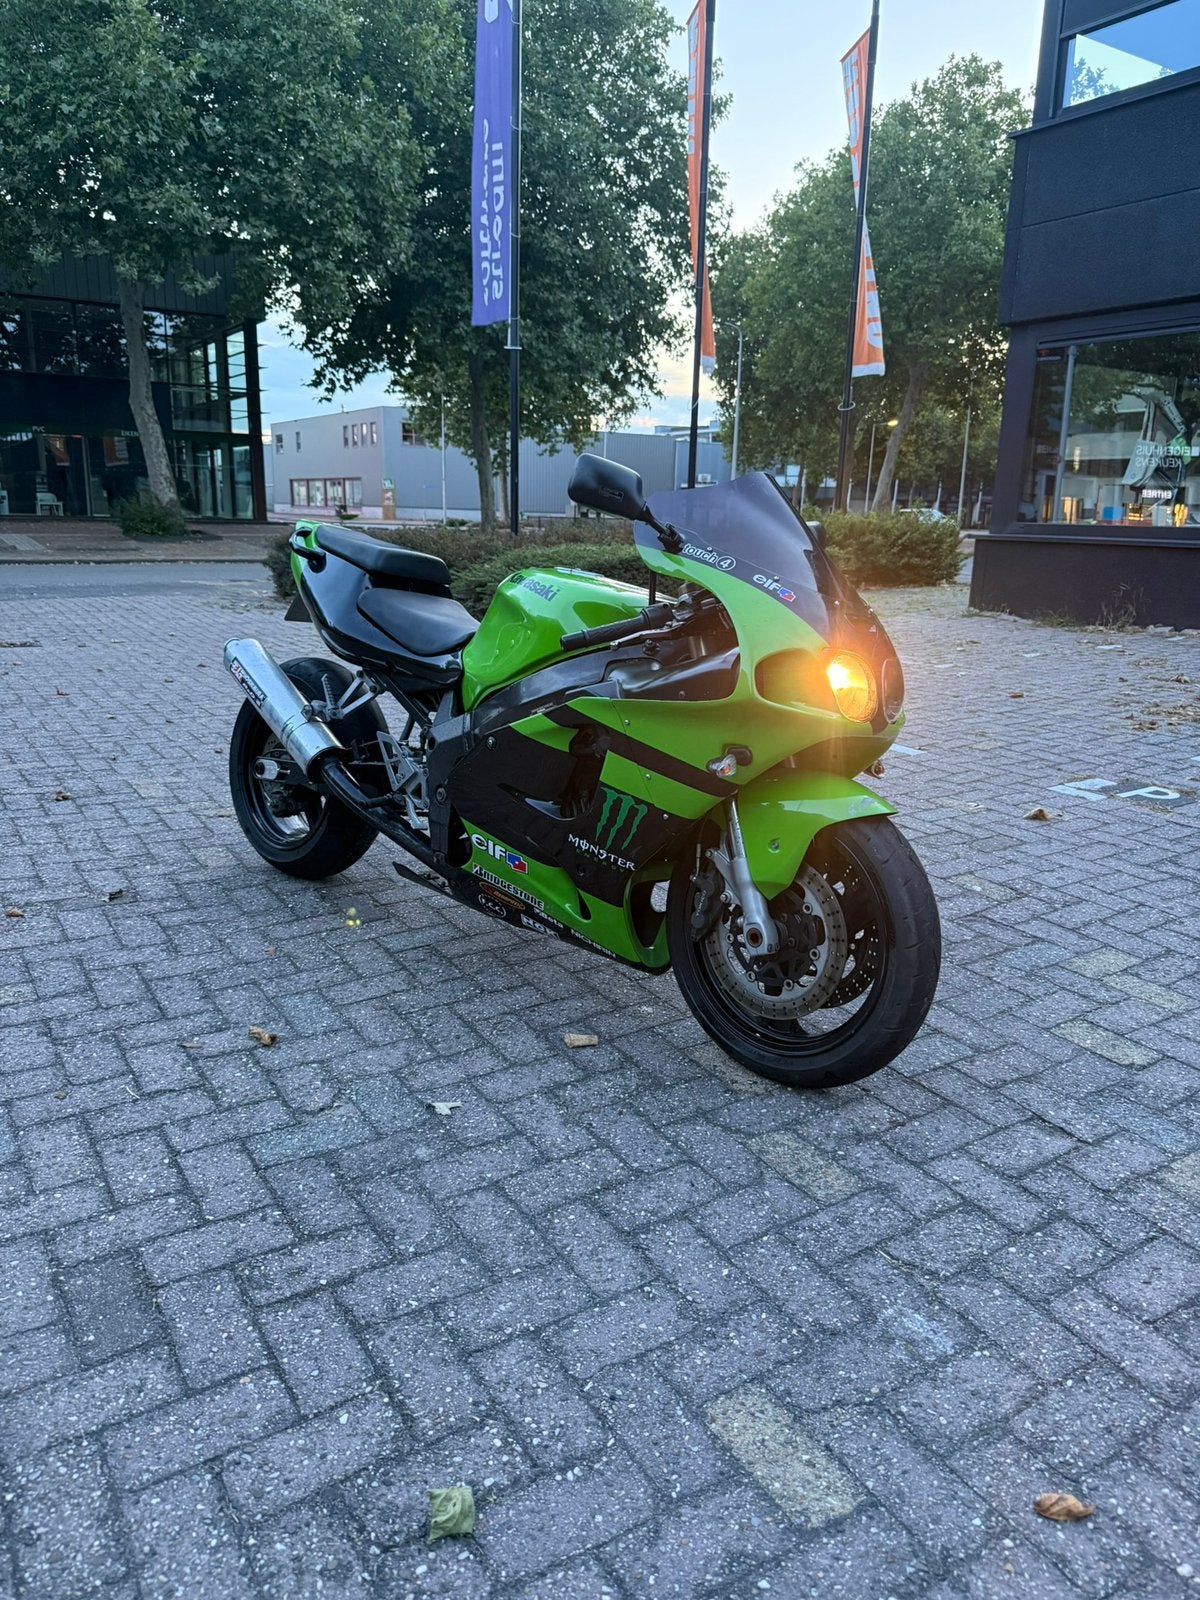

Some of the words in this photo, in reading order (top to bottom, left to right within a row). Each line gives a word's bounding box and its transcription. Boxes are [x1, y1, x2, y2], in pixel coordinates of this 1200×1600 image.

[682, 543, 718, 564] touch
[568, 833, 635, 871] MONSTER
[472, 863, 545, 911] BRIDGESTONE
